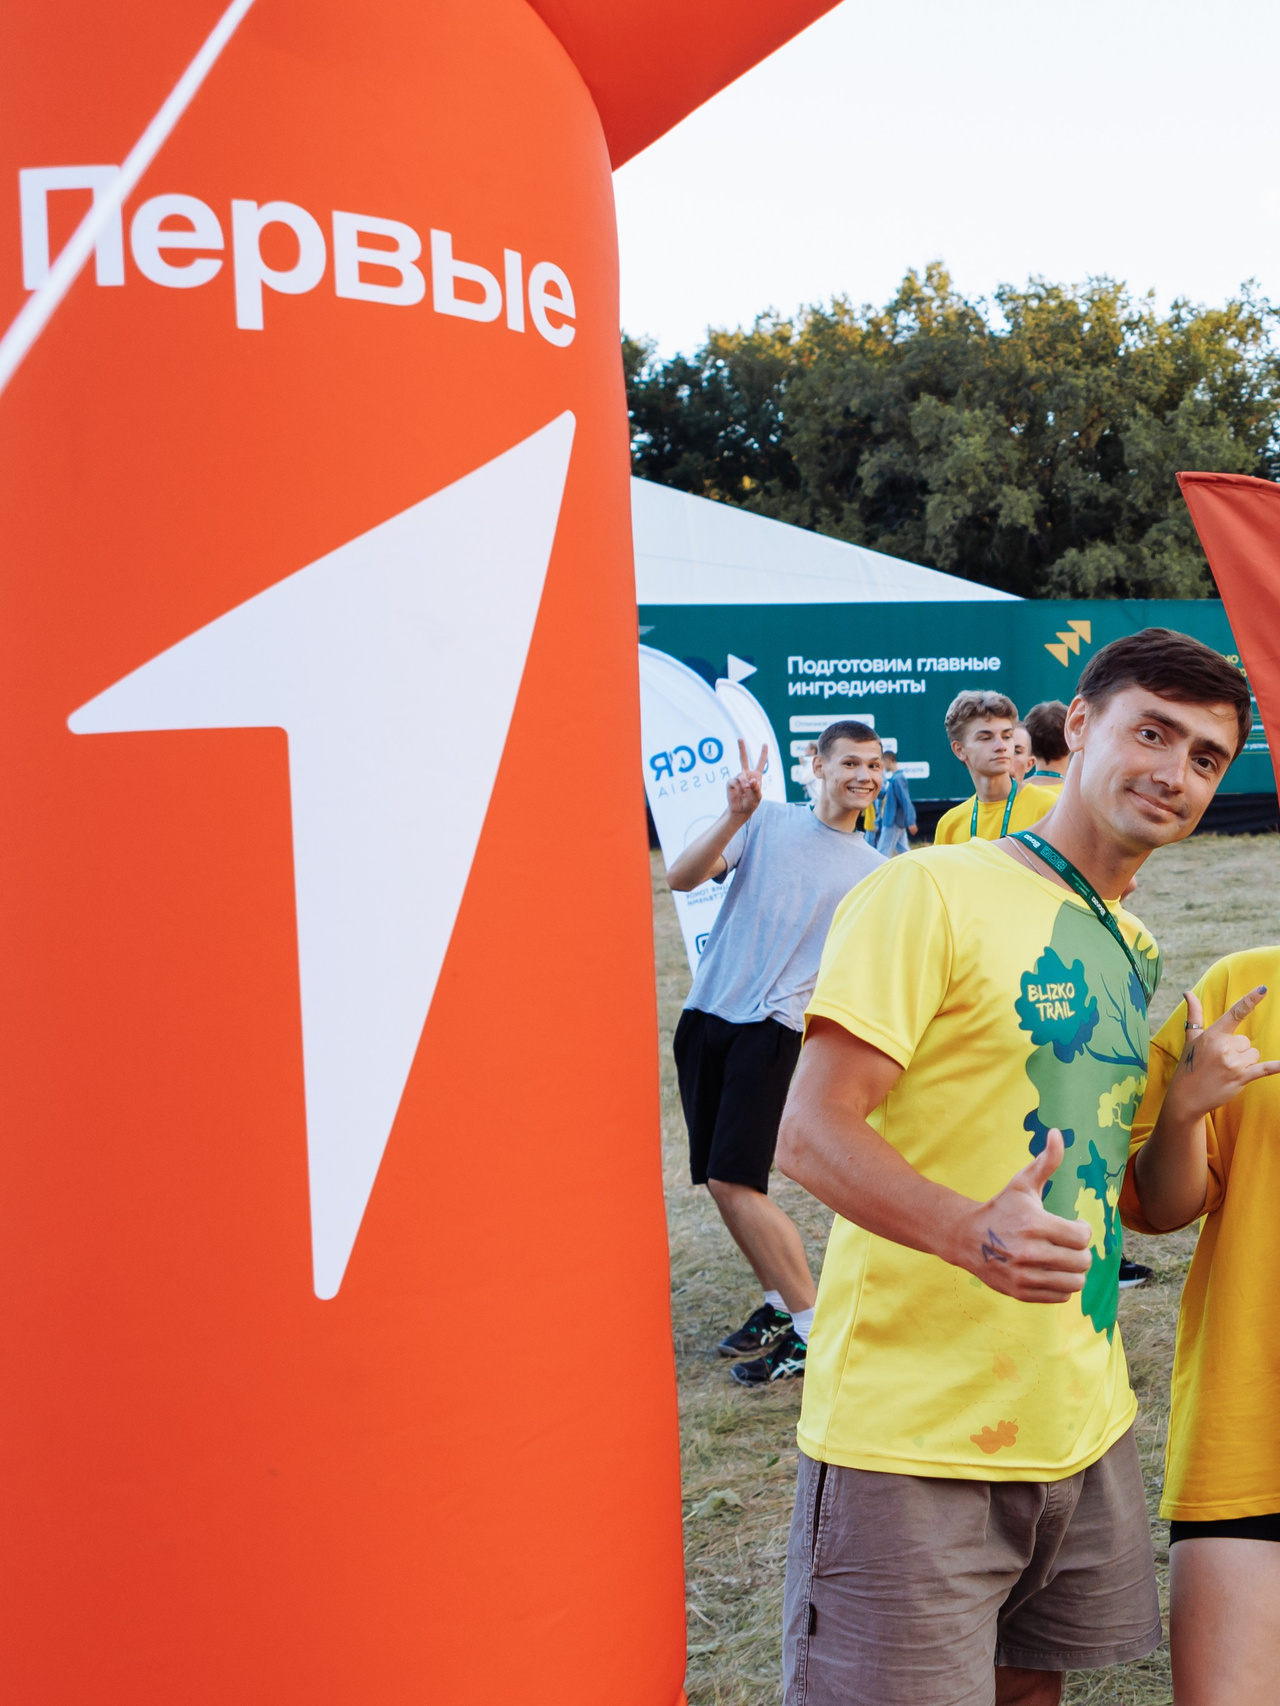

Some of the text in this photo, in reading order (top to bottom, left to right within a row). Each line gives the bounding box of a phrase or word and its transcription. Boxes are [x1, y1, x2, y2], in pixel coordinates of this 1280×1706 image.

[19, 165, 577, 347] Первые
[787, 655, 1001, 677] Подготовим главные
[788, 679, 926, 699] ингредиенты
[1027, 982, 1075, 1001] BLIZKO
[1035, 1001, 1075, 1021] TRAIL
